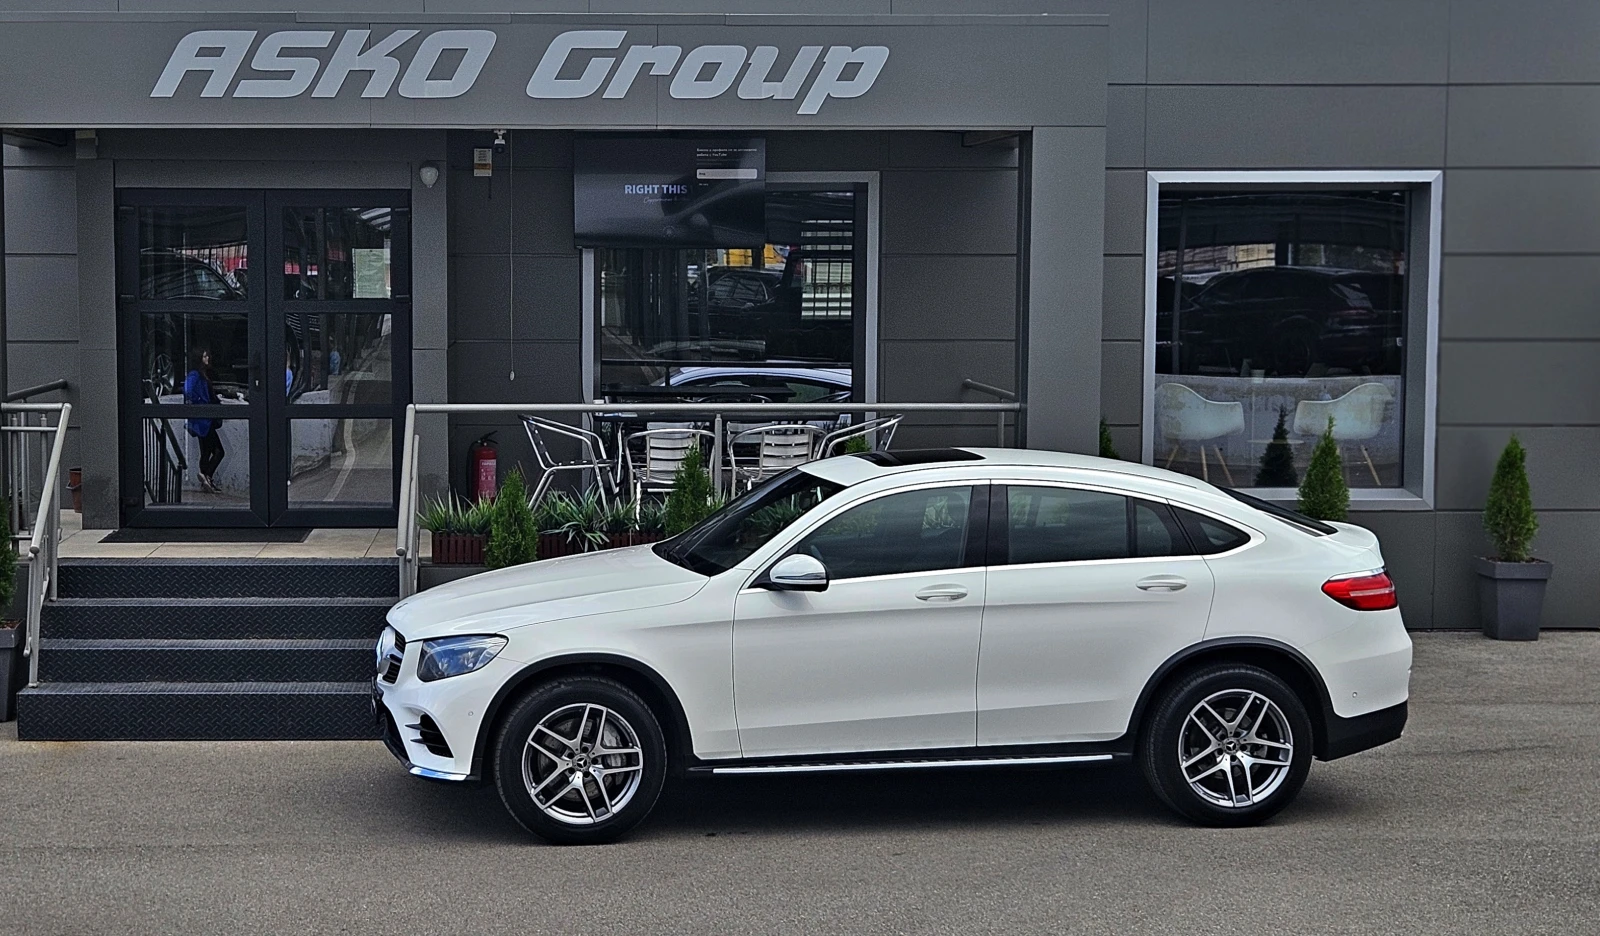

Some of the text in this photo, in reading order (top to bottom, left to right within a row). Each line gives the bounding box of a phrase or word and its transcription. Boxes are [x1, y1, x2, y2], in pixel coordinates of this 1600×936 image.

[149, 29, 890, 115] ASKO Group
[624, 184, 688, 194] RIGHT THIS
